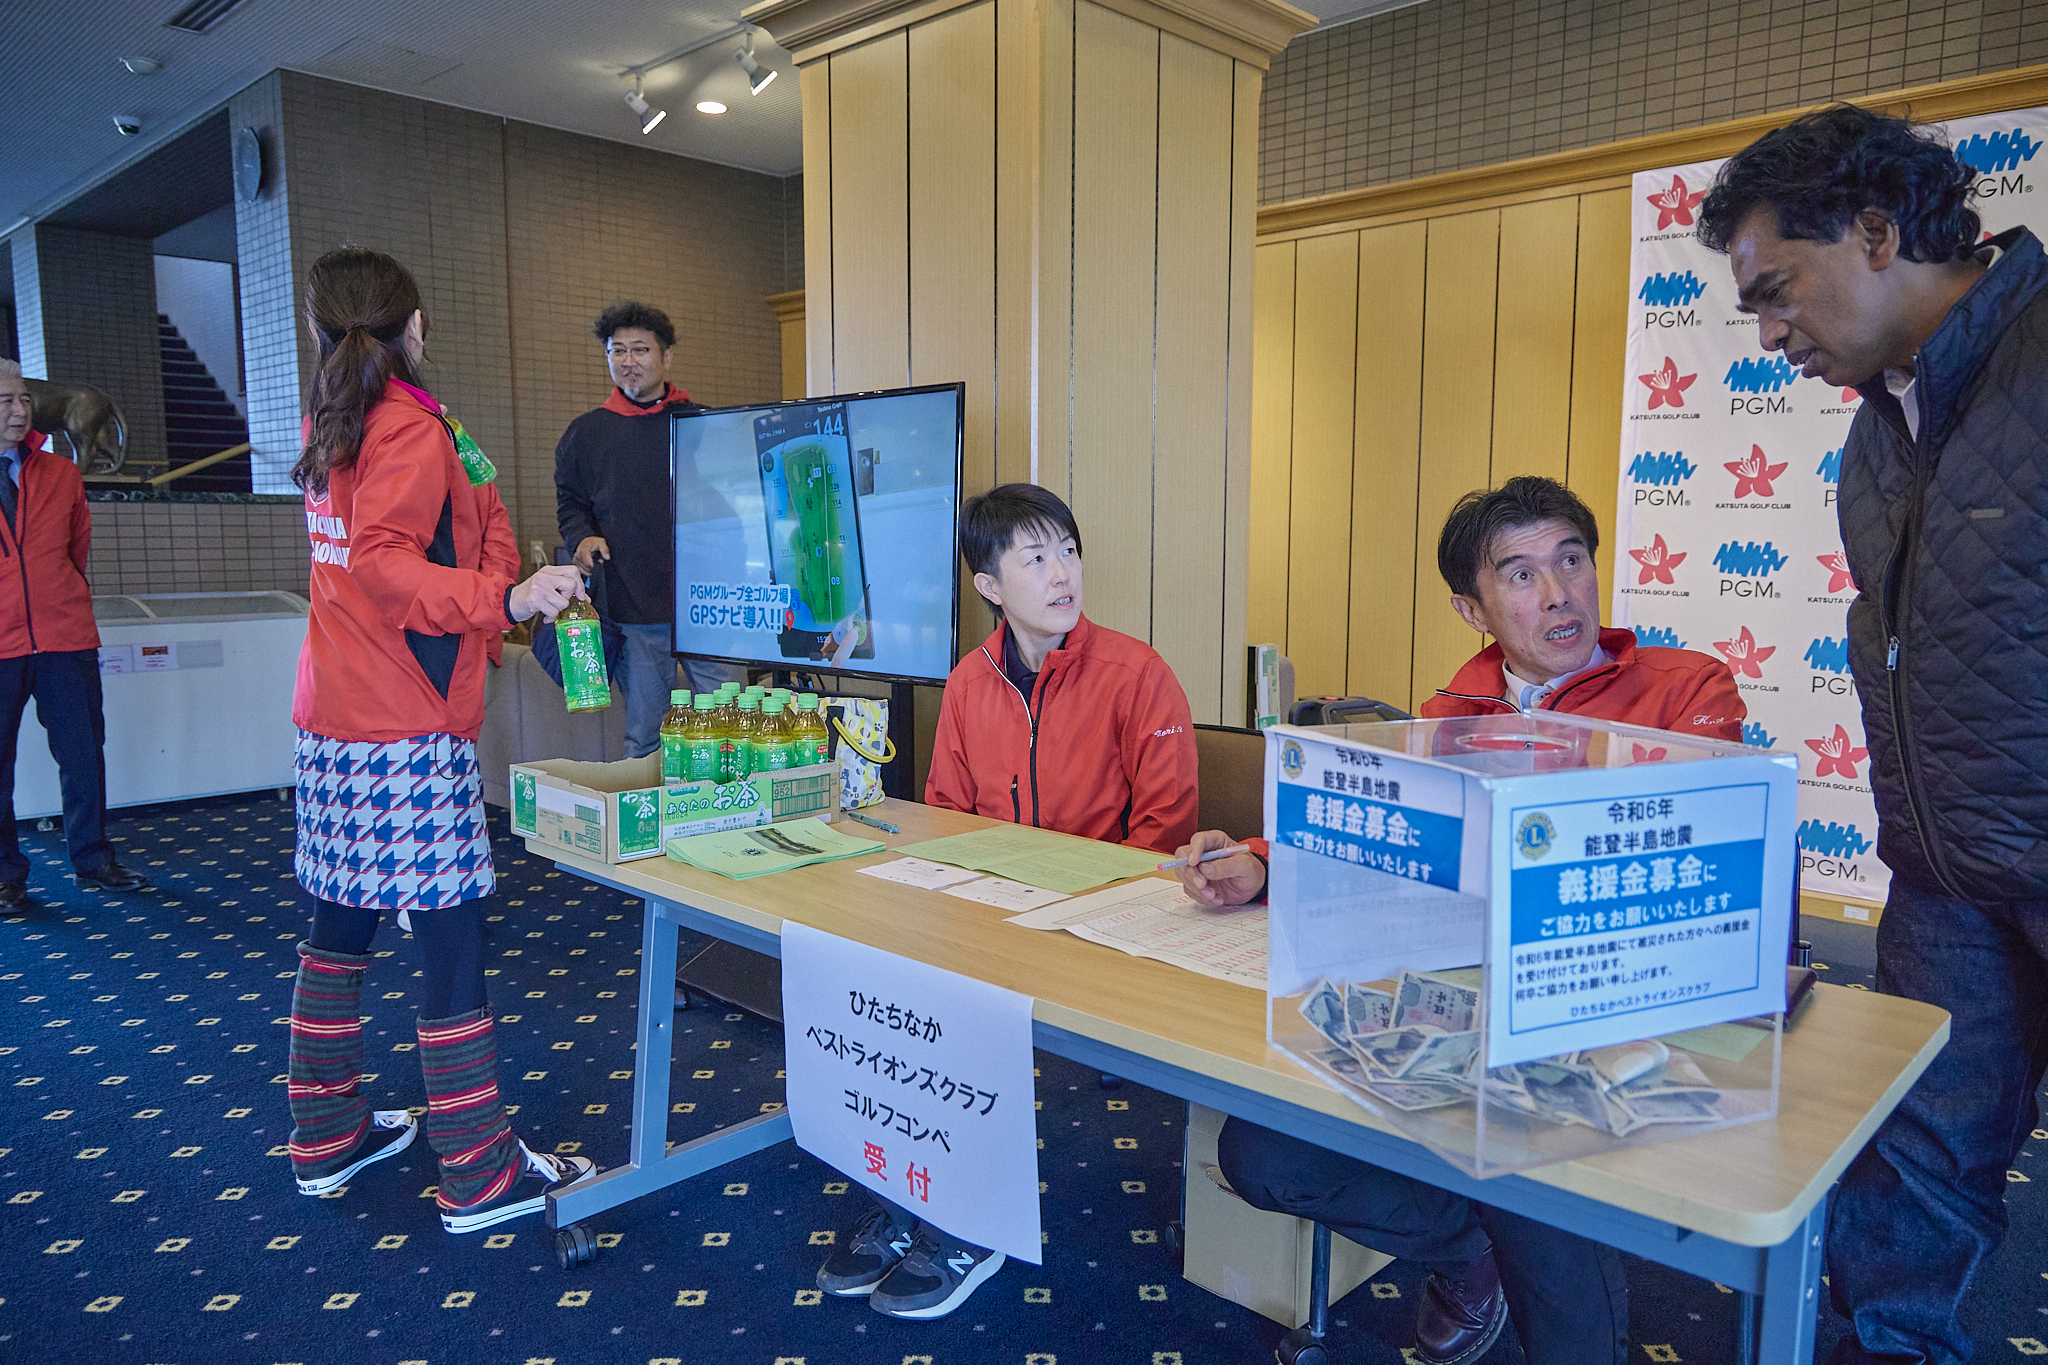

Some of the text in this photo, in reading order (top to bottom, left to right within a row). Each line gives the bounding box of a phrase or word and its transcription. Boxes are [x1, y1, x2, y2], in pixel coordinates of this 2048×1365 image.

[1976, 174, 2024, 198] GM
[1640, 234, 1670, 242] KATSUTA
[1645, 310, 1695, 329] PGM
[1730, 396, 1786, 415] PGM
[1820, 407, 1857, 415] KATSUTA
[813, 413, 844, 441] 144
[1634, 489, 1684, 506] PGM
[831, 576, 840, 585] OB
[1719, 579, 1774, 598] PGM
[690, 584, 789, 604] PGMグループ全ゴルフ場
[774, 787, 790, 798] 952
[1323, 769, 1401, 802] 能登半島地震
[1832, 783, 1854, 791] GOLF
[1305, 793, 1422, 848] 義援金募金に
[1607, 798, 1674, 824] 令和6年
[1584, 825, 1693, 857] 能登半島地震
[1293, 830, 1433, 882] ご協力をお願いいたします
[1801, 856, 1858, 881] PGM
[1558, 853, 1718, 905] 義援金募金に
[1540, 892, 1732, 937] ご協力をお願いいたします
[1570, 982, 1711, 1018] ひたちなかベストライオンズクラブ
[849, 990, 942, 1043] ひたちなか
[806, 1025, 998, 1116] ベストライオンズクラブ
[844, 1089, 951, 1153] ゴルフコンペ
